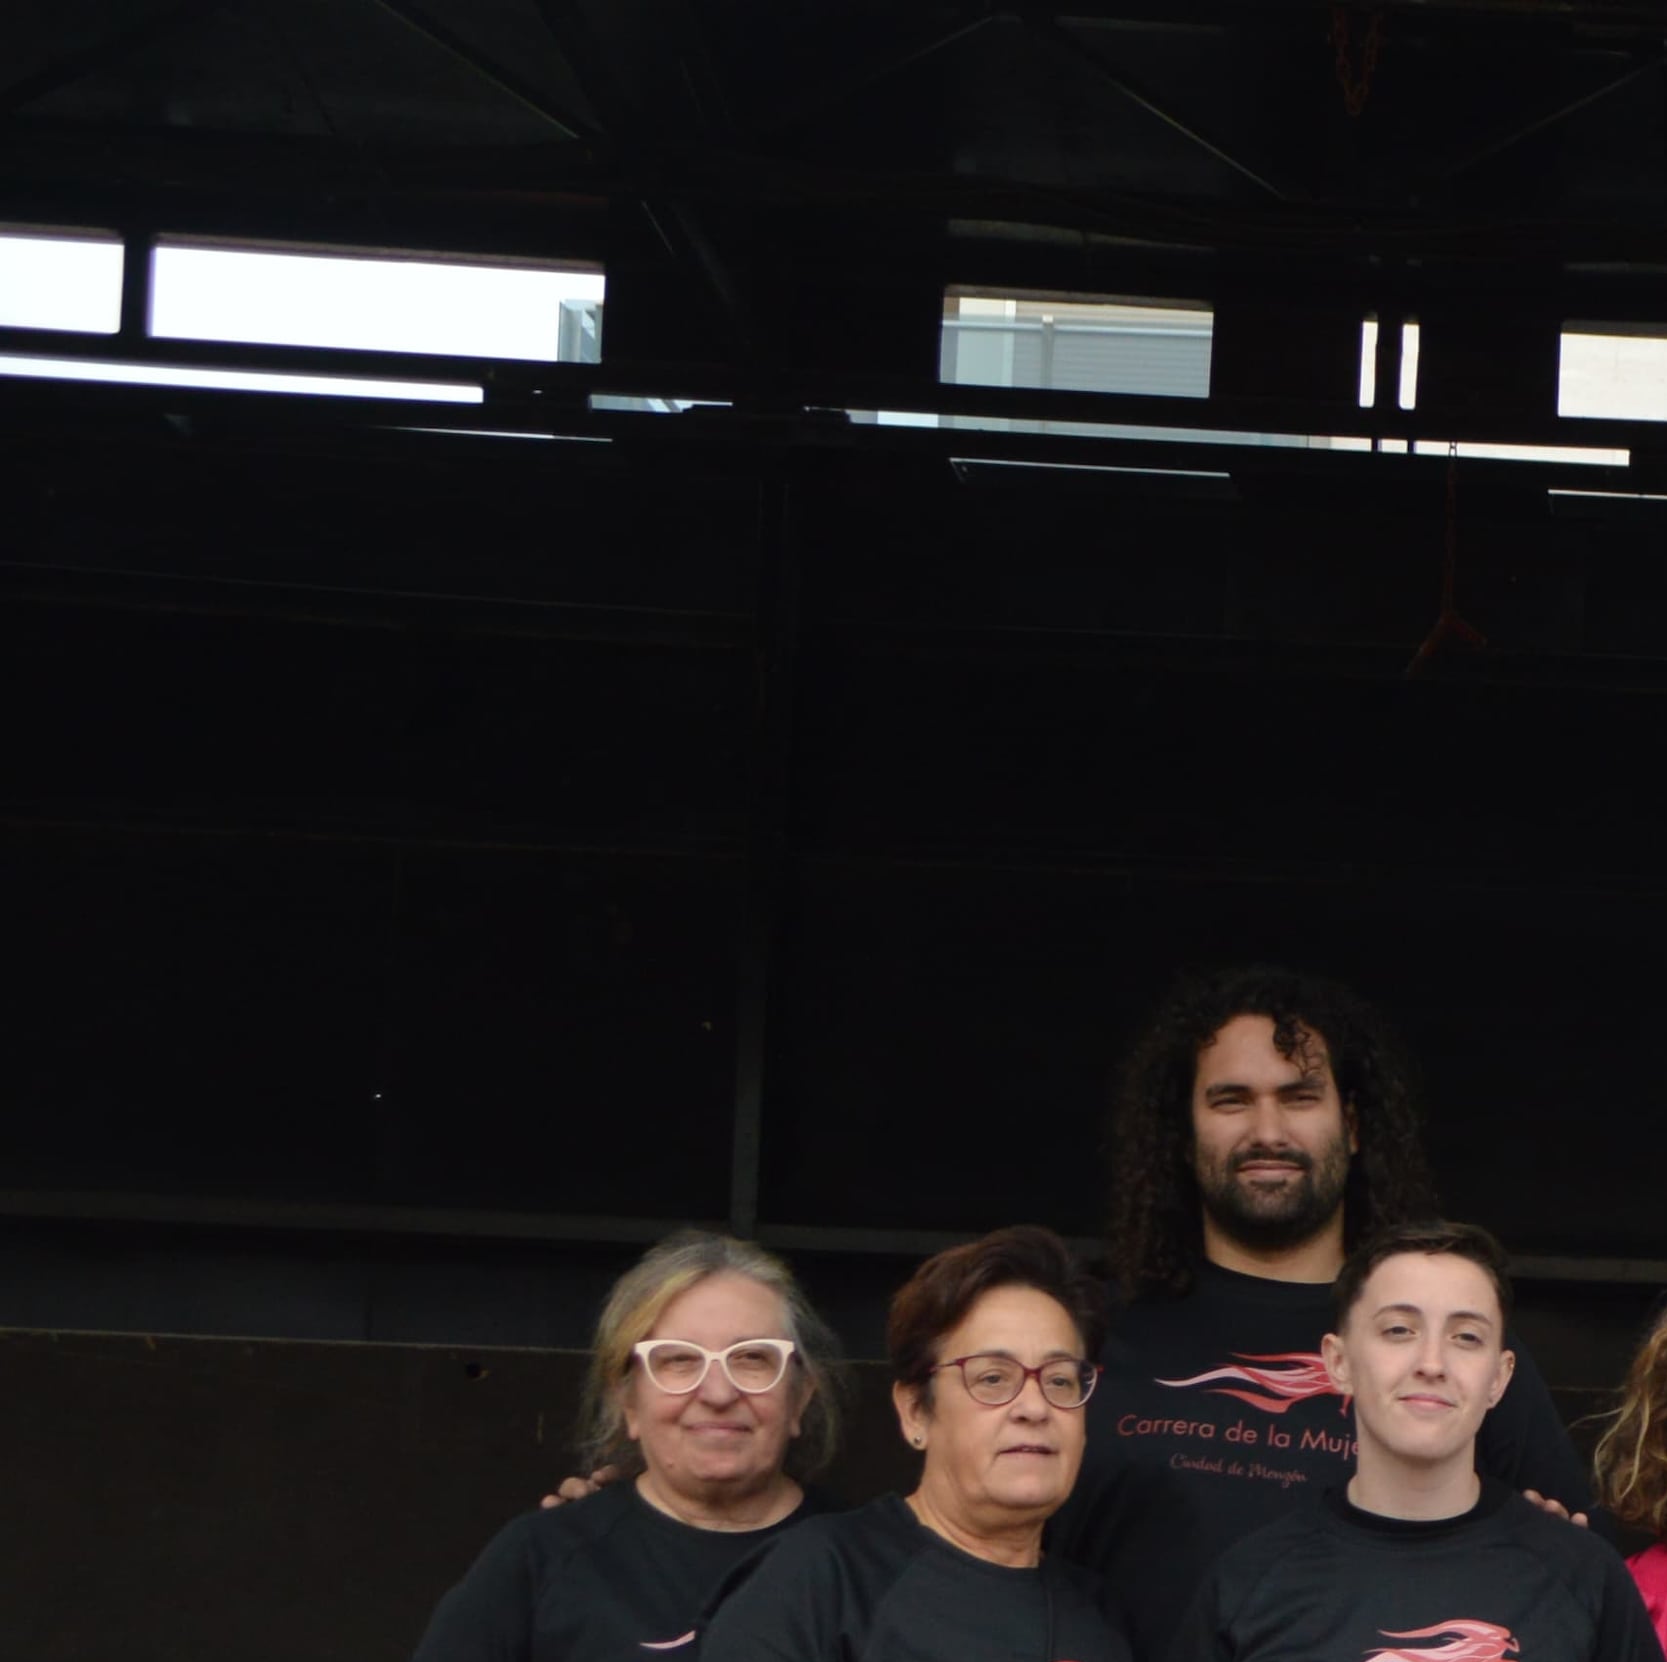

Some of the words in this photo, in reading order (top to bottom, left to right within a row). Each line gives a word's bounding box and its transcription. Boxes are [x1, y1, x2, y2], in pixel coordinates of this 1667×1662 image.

[1117, 1413, 1216, 1438] Carrera
[1225, 1420, 1258, 1444] de
[1268, 1423, 1290, 1448] la
[1300, 1429, 1360, 1460] Muje
[1227, 1461, 1244, 1476] de
